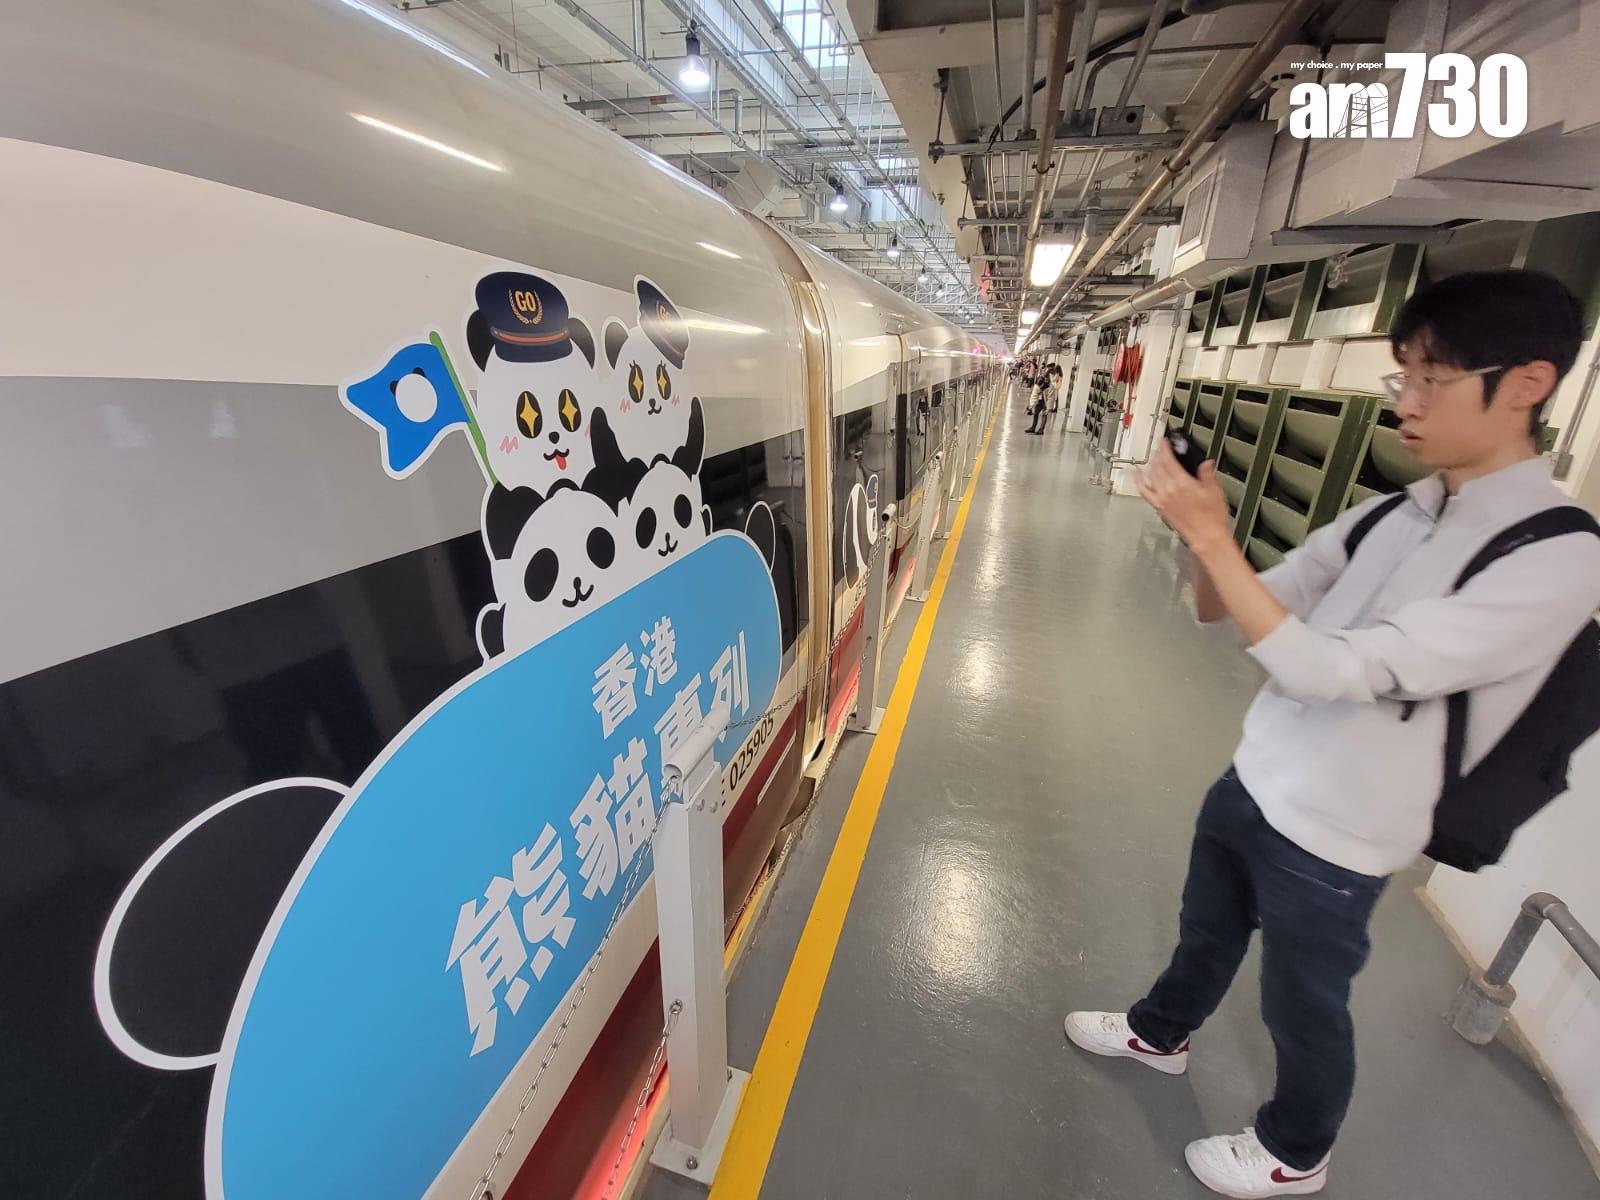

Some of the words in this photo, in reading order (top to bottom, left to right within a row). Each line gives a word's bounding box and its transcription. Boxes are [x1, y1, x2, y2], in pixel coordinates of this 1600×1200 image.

[515, 291, 537, 312] GO
[592, 616, 679, 740] 香港
[729, 714, 774, 791] 025905
